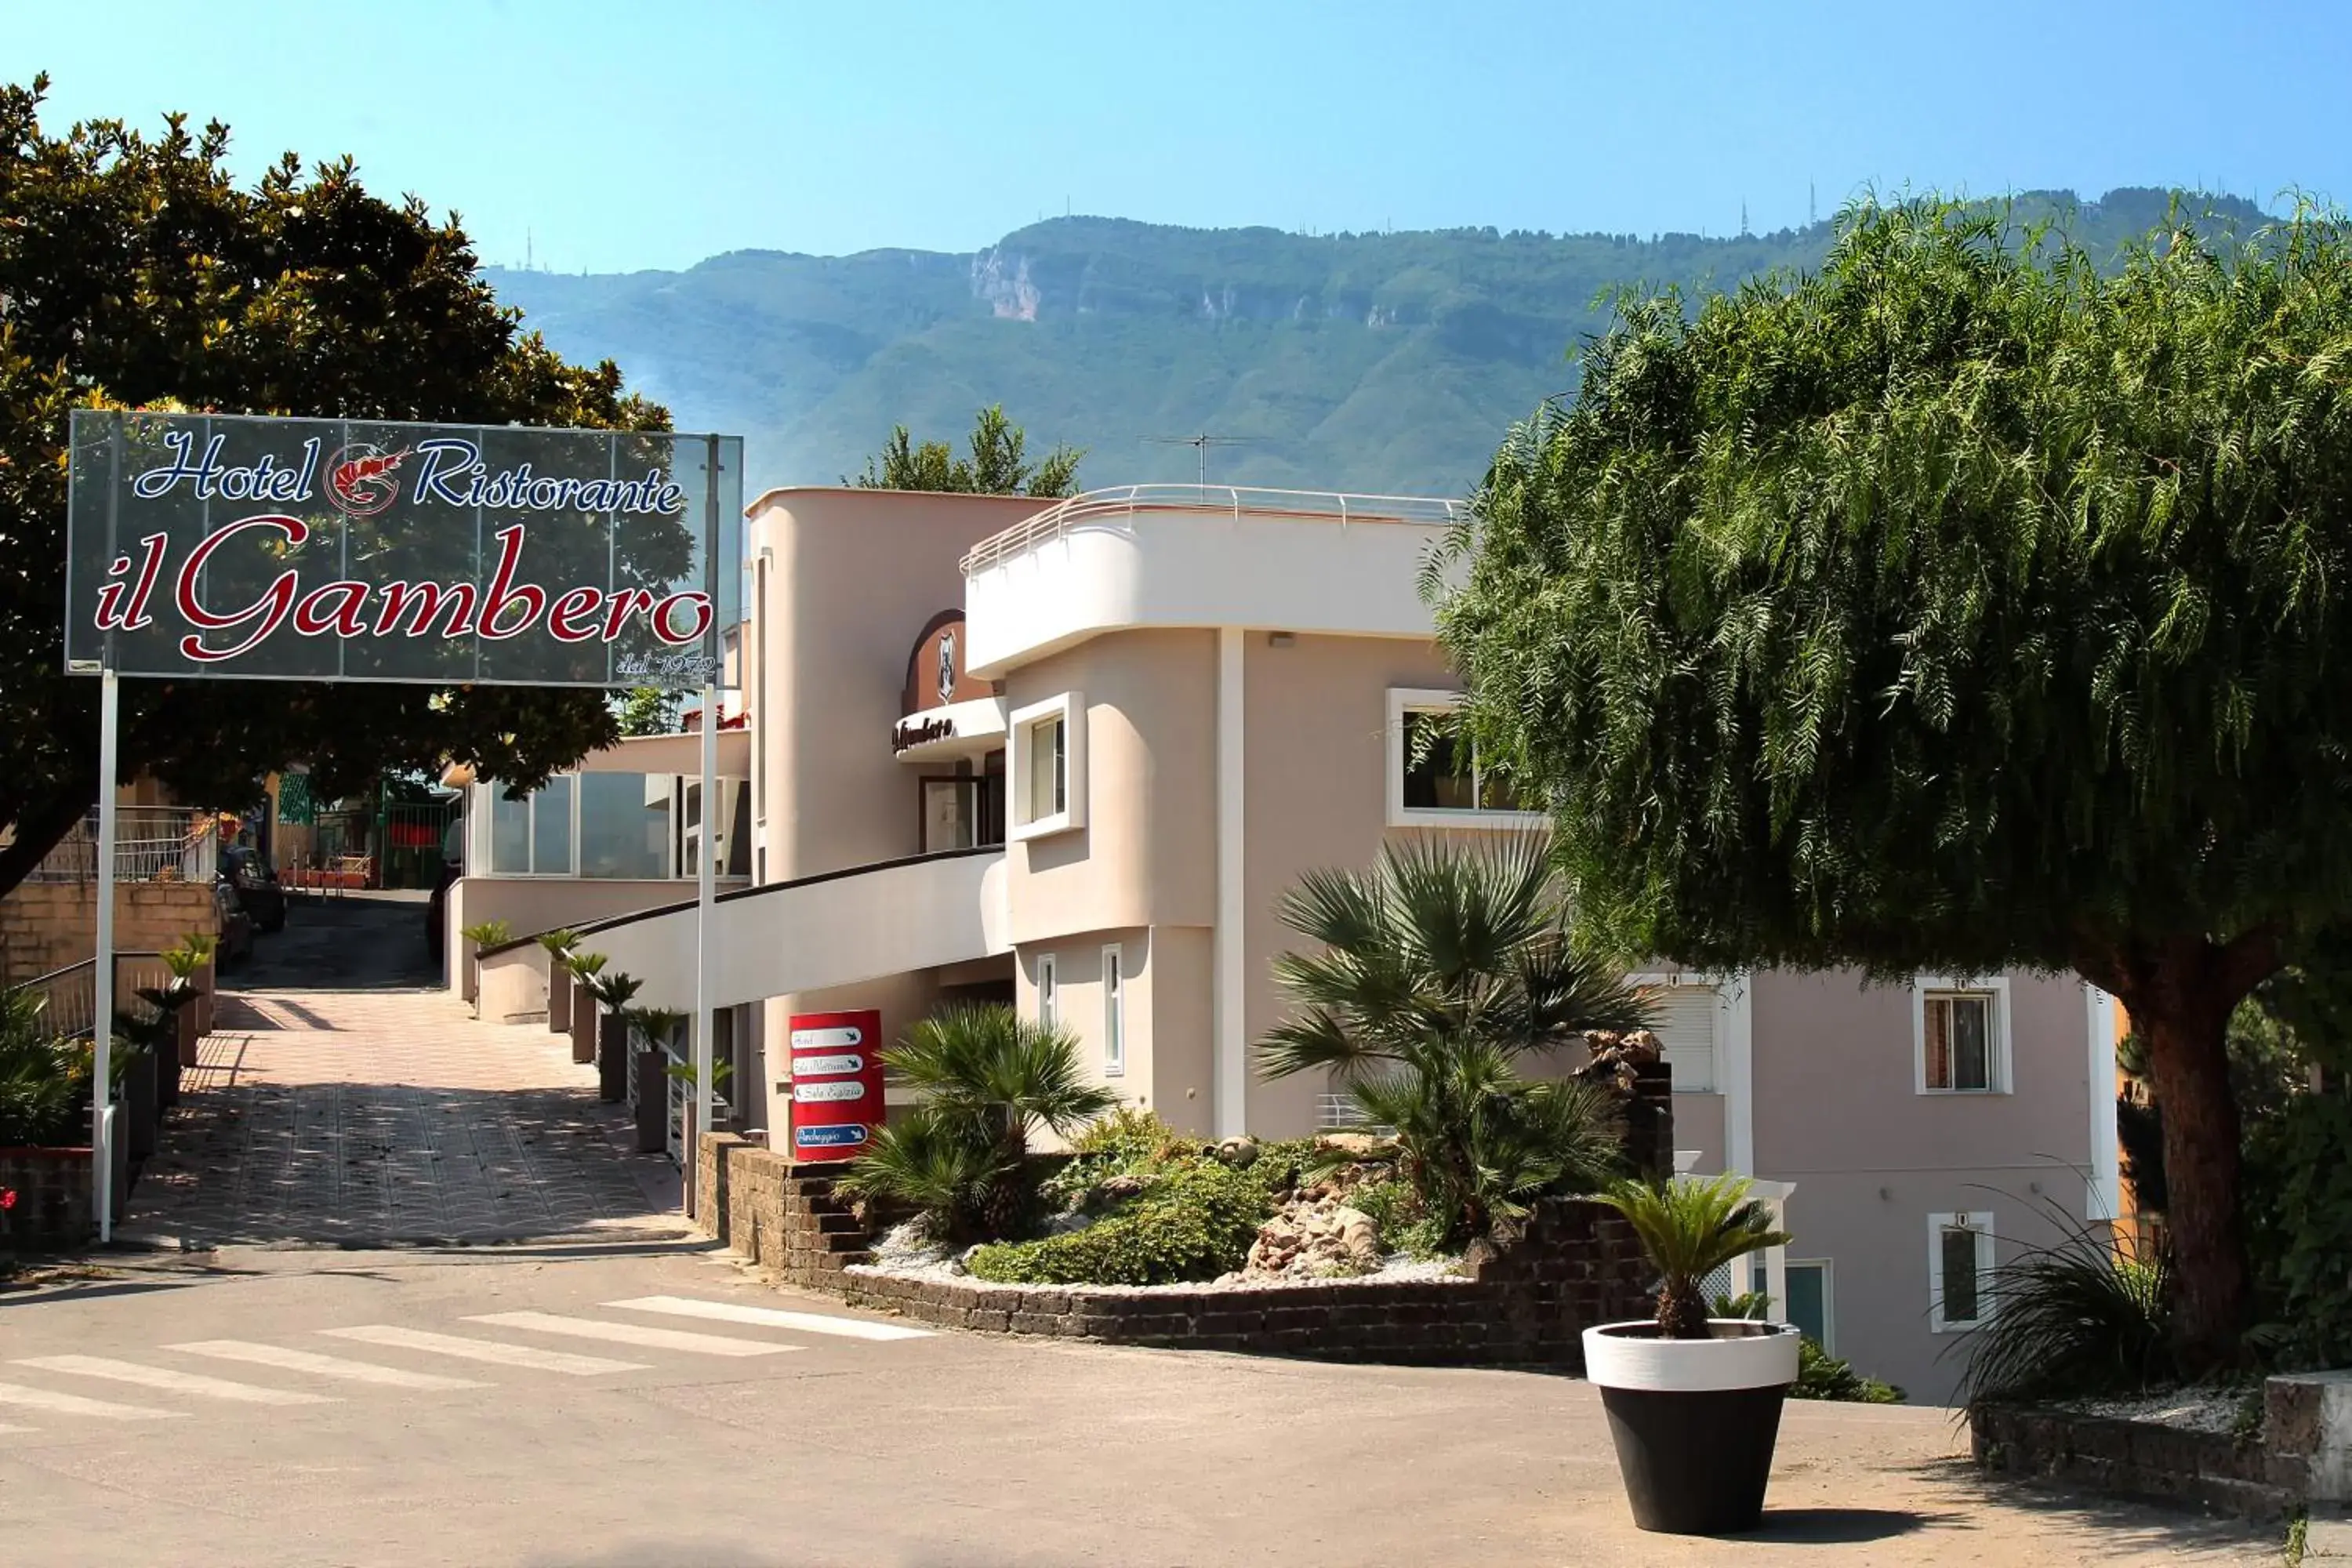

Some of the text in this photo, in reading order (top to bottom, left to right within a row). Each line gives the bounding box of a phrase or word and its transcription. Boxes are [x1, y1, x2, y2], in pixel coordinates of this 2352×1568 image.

[134, 431, 683, 514] Hotel Ristorante
[95, 514, 713, 662] il Gambero
[656, 655, 716, 677] 1972
